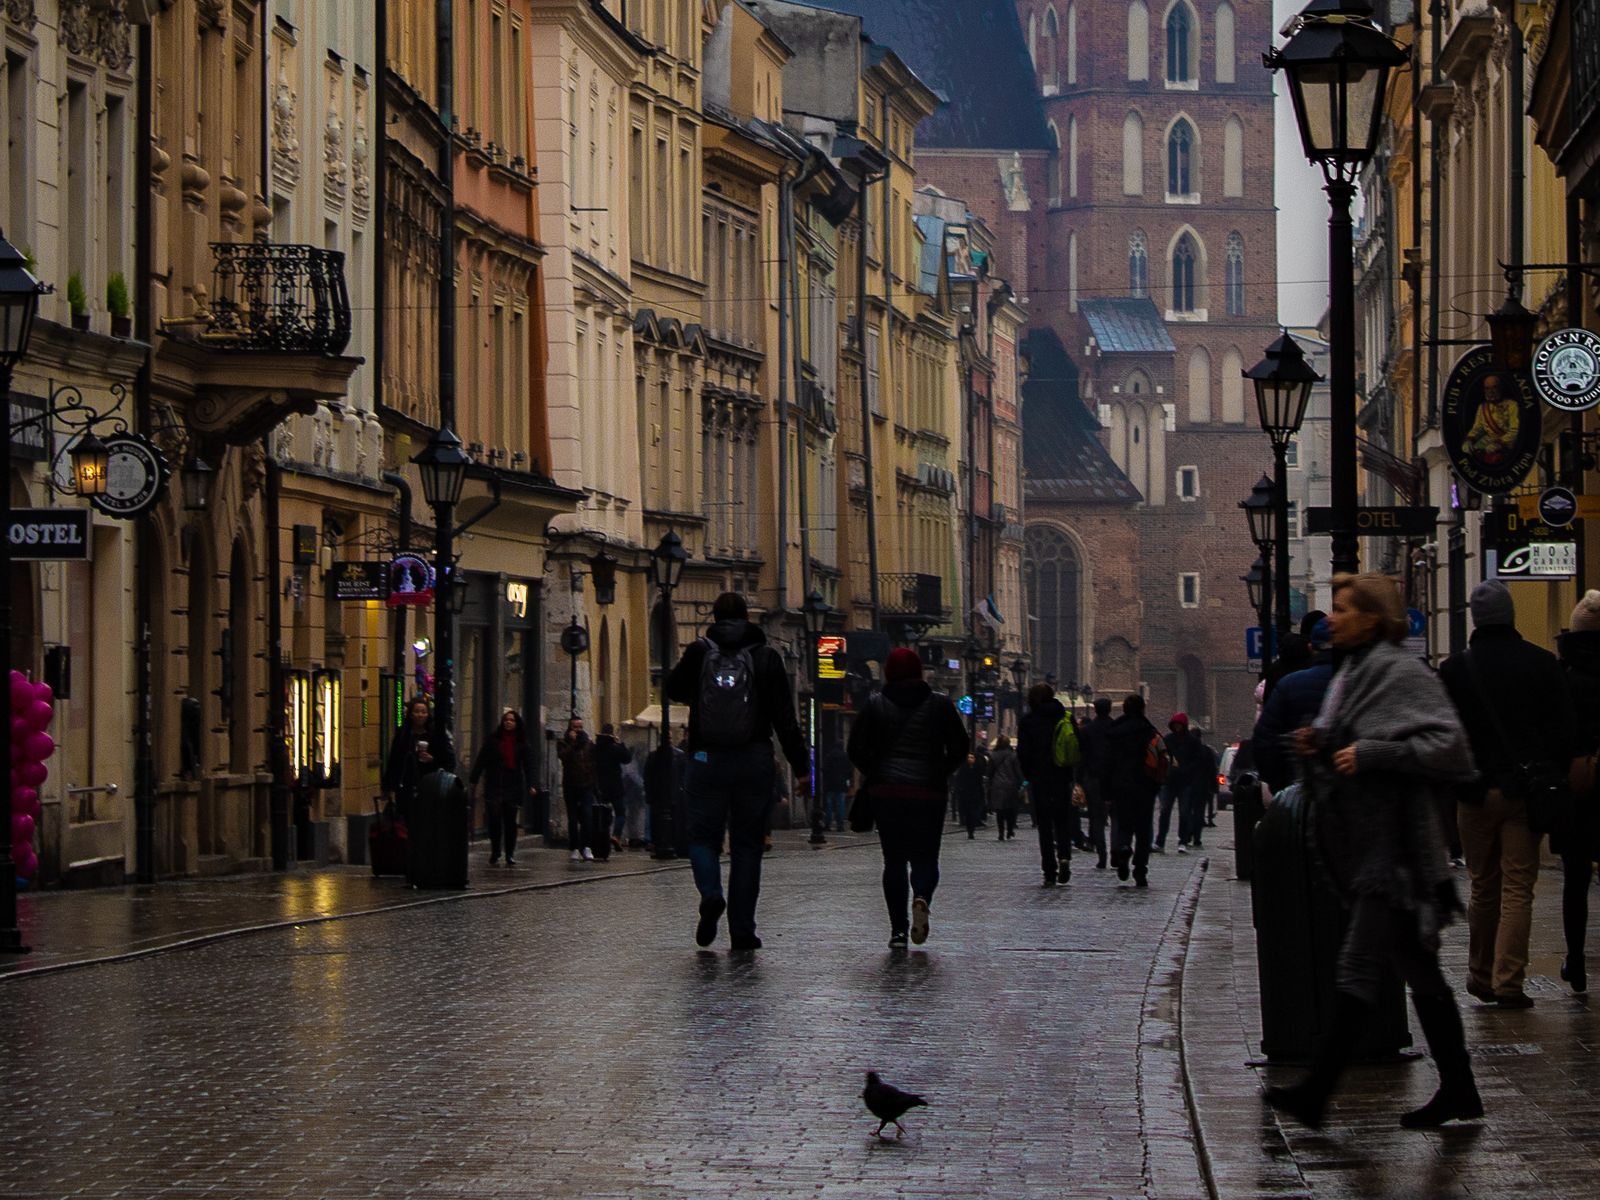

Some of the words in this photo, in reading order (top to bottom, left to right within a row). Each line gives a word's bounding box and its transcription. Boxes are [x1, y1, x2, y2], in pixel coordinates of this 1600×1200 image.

[1536, 333, 1600, 370] ROCK'N'RO
[1447, 387, 1461, 415] PUB
[1540, 380, 1571, 404] TATTOO
[1357, 511, 1402, 528] OTEL
[9, 523, 82, 544] OSTEL
